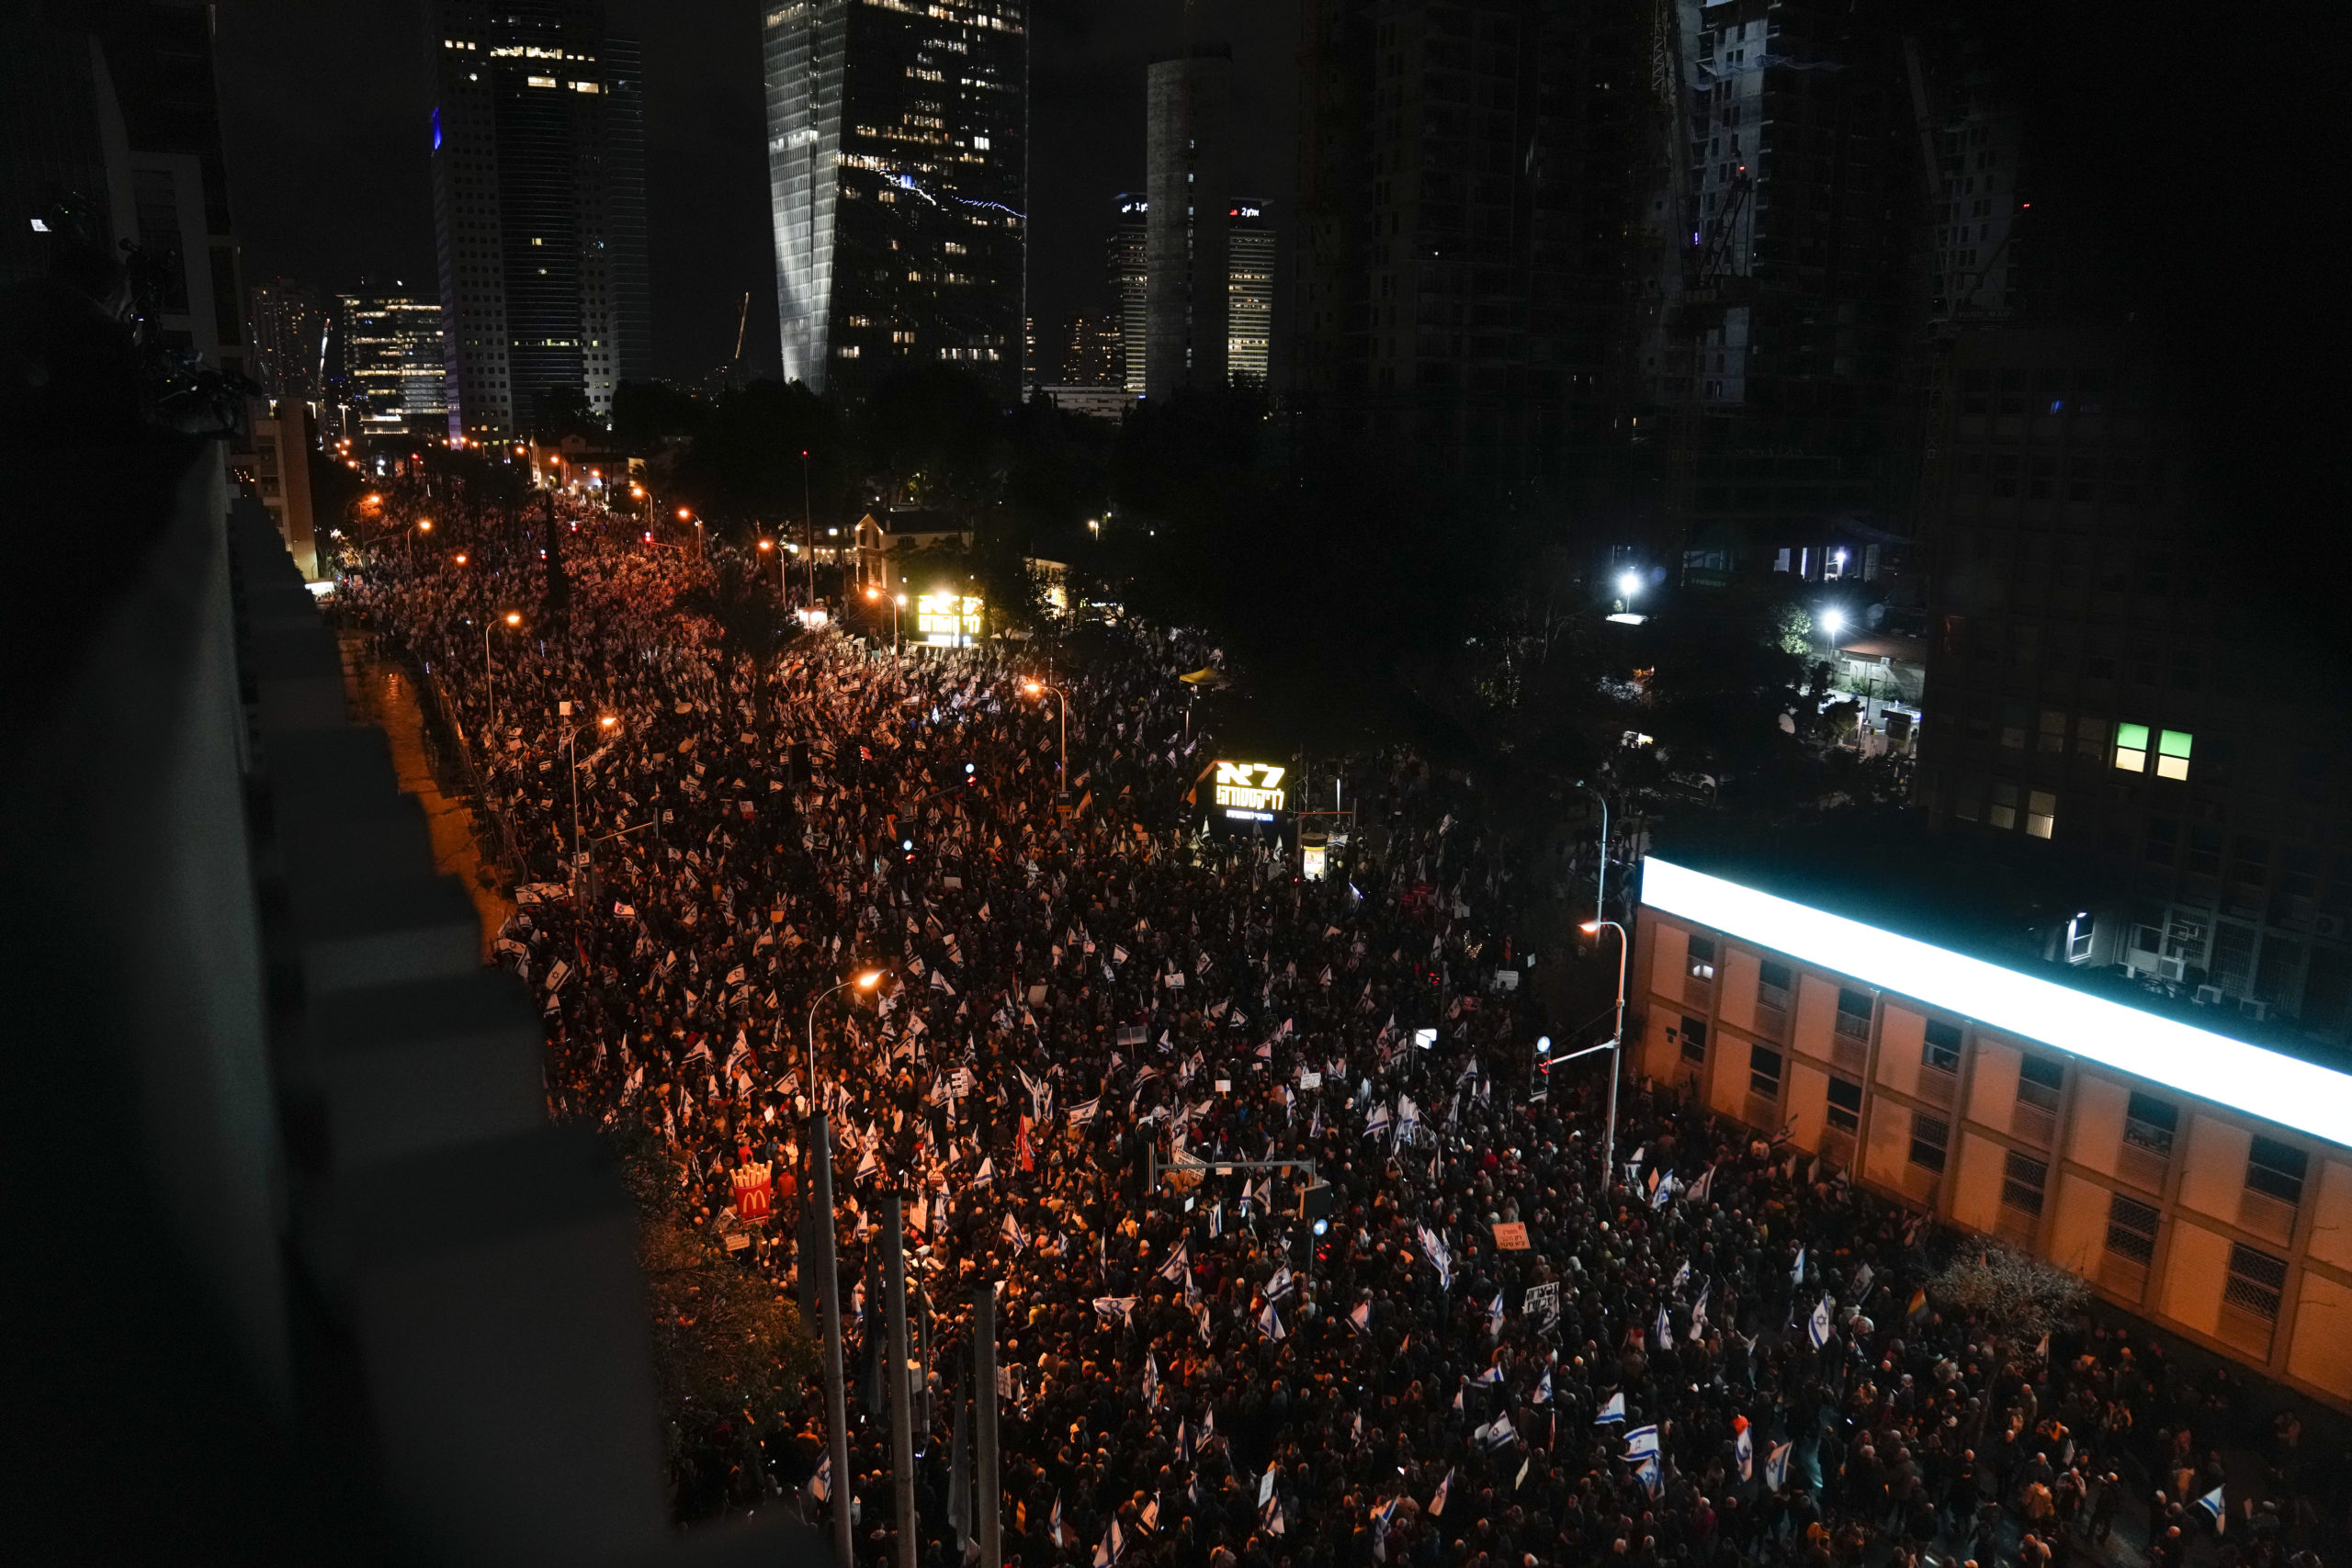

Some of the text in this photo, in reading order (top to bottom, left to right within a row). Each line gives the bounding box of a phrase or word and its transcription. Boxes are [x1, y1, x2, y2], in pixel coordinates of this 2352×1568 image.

[1241, 207, 1247, 216] 2
[1216, 762, 1285, 787] לא
[1216, 785, 1284, 810] לדיקטטורה!
